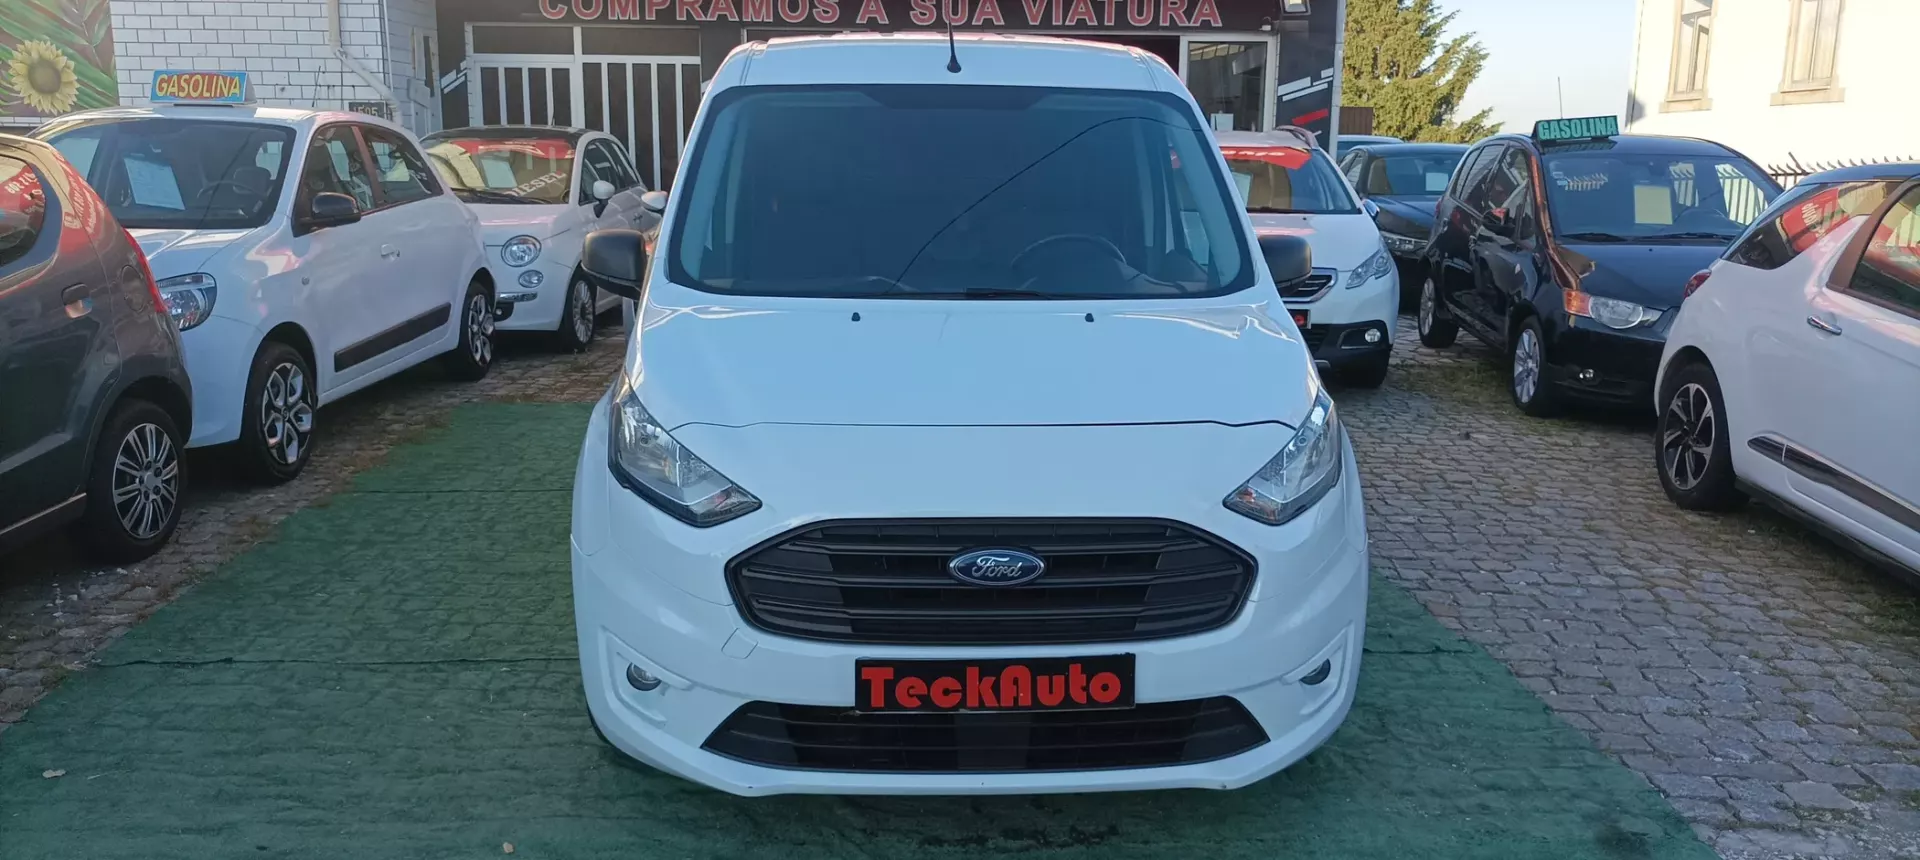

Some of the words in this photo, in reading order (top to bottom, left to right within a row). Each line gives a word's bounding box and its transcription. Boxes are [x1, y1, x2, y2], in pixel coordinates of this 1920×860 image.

[538, 0, 841, 23] COMPRAMOS
[855, 0, 889, 24] A
[909, 0, 1005, 26] SUA
[1020, 0, 1223, 27] VIATURA
[155, 73, 241, 98] GASOLINA
[1539, 117, 1617, 139] GASOLINA
[971, 555, 1022, 578] Ford
[861, 663, 1122, 709] TeckAuto
